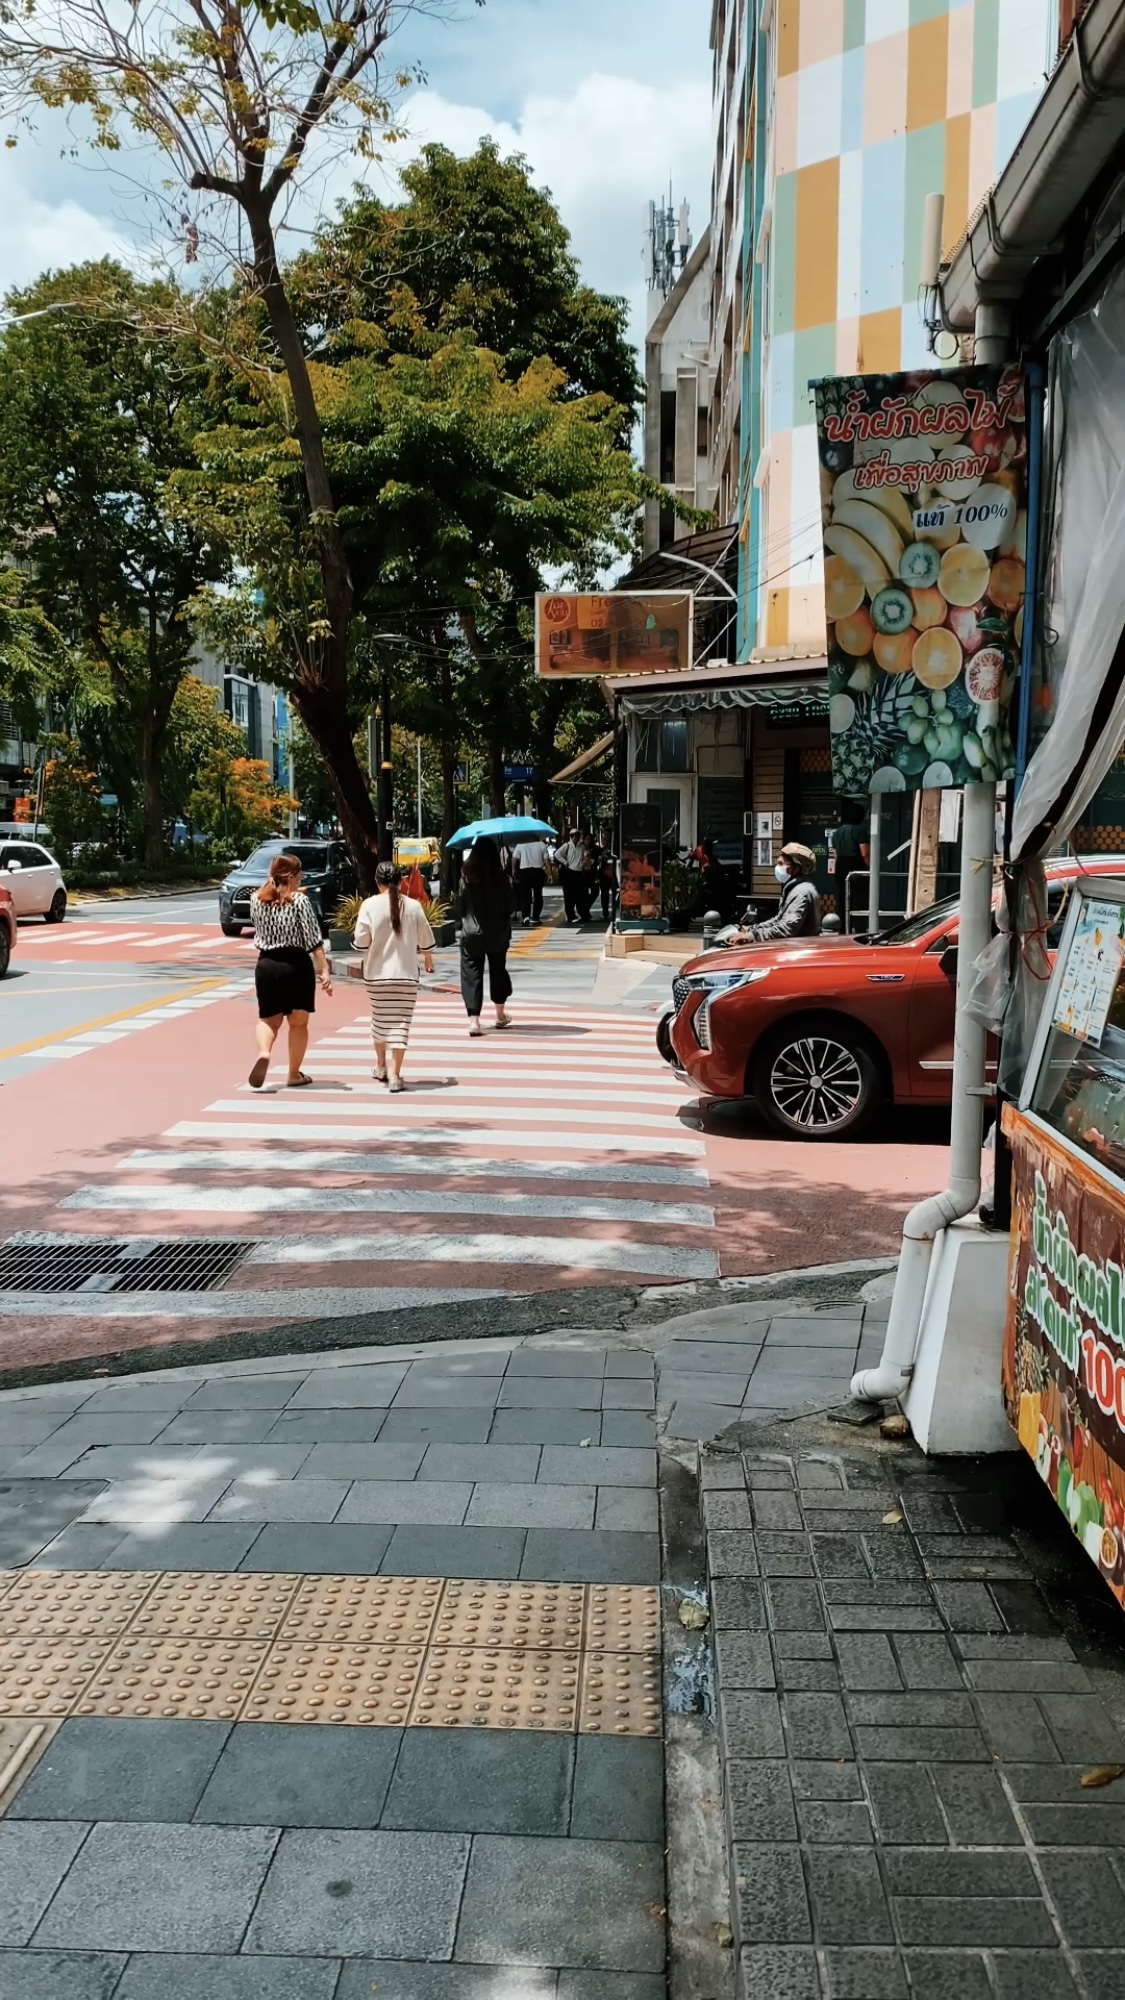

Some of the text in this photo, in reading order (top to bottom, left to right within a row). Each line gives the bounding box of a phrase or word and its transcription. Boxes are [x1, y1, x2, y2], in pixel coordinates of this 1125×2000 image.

[825, 387, 1016, 441] น้ำผักผลไม้
[855, 450, 989, 492] เพื่อสุขภาพ
[916, 502, 1008, 528] แท้ 100%
[1033, 1171, 1125, 1343] น้ำผักผลไ
